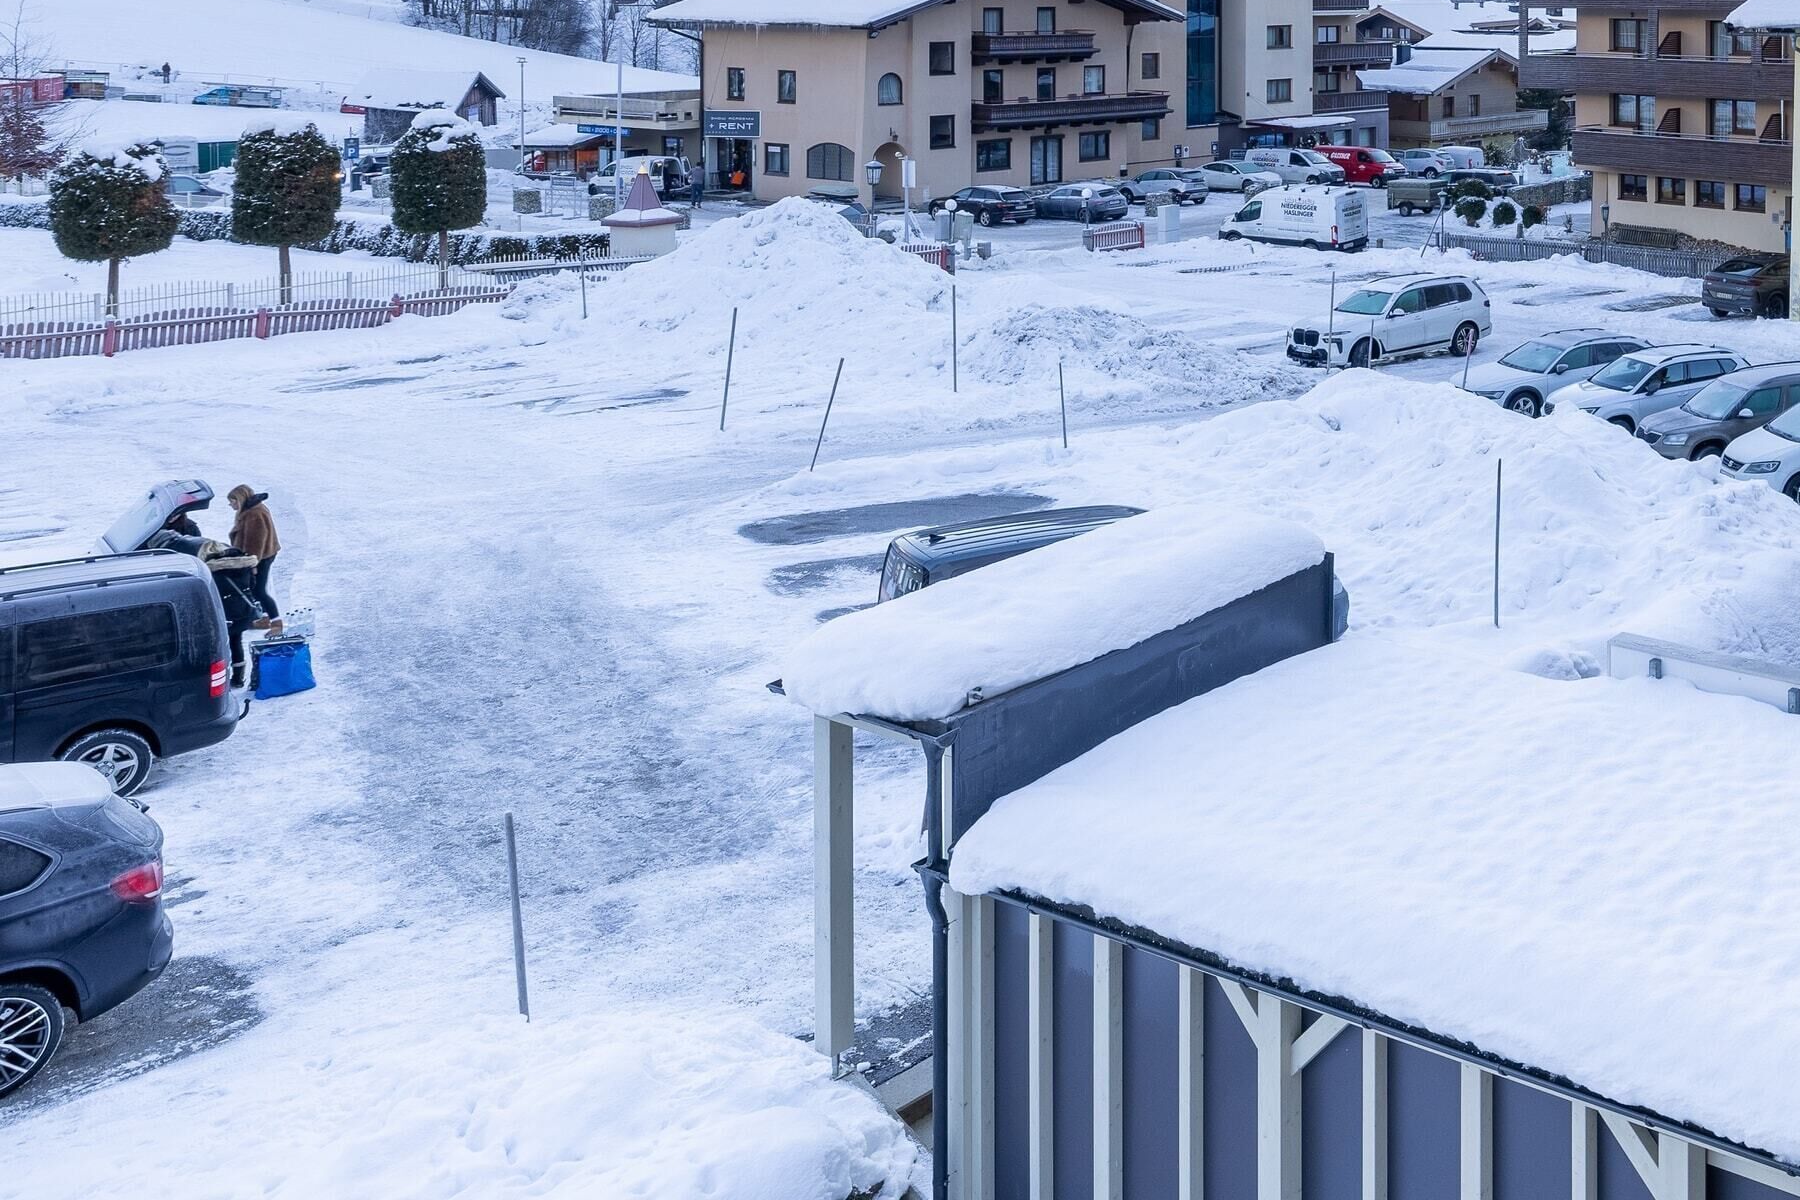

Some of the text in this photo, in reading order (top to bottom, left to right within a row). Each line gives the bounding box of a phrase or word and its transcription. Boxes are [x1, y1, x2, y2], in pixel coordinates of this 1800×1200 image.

[719, 122, 754, 130] RENT
[1280, 202, 1317, 211] NIEDEREGGER
[1283, 209, 1314, 217] HASLINGER
